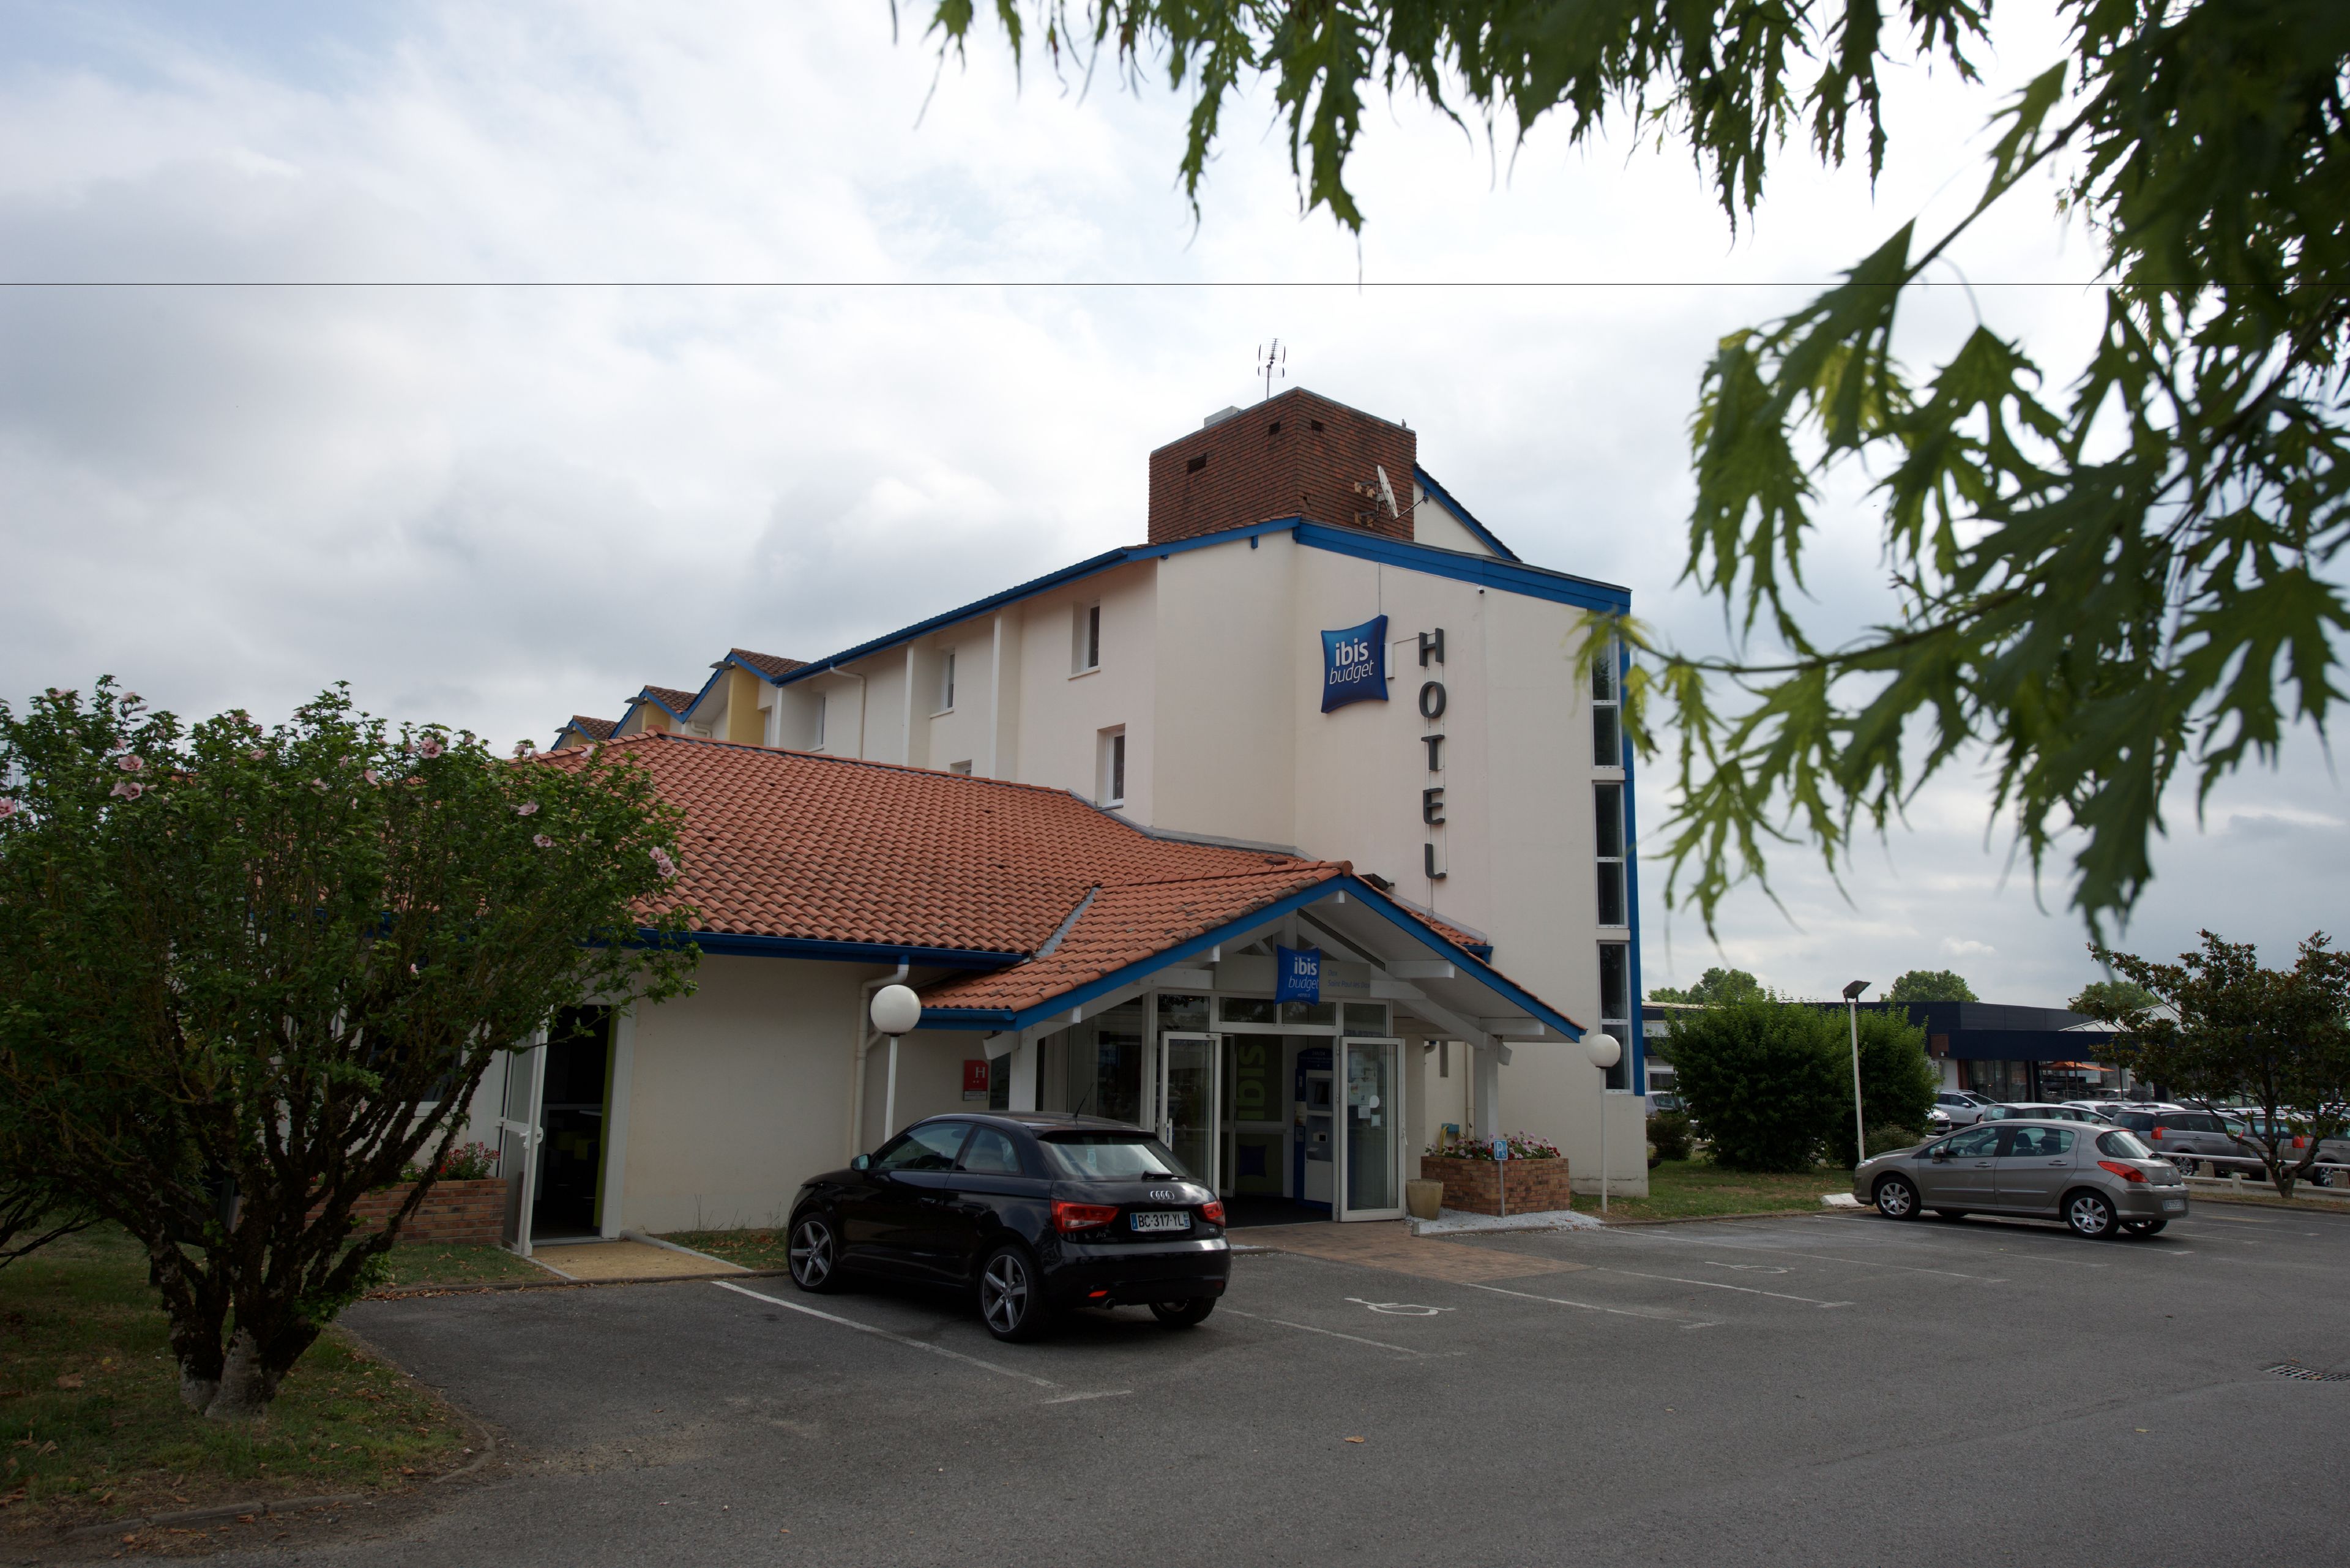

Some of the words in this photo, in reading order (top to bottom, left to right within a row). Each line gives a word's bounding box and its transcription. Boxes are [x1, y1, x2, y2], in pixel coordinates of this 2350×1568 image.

[1335, 638, 1369, 666] ibis
[1329, 660, 1374, 685] budget
[1419, 628, 1447, 879] HOTEL
[1294, 957, 1318, 976] ibis
[1288, 976, 1319, 992] budget
[1327, 979, 1341, 988] Saint
[1341, 980, 1352, 988] Paul
[975, 1067, 985, 1078] H
[1496, 1142, 1503, 1157] P
